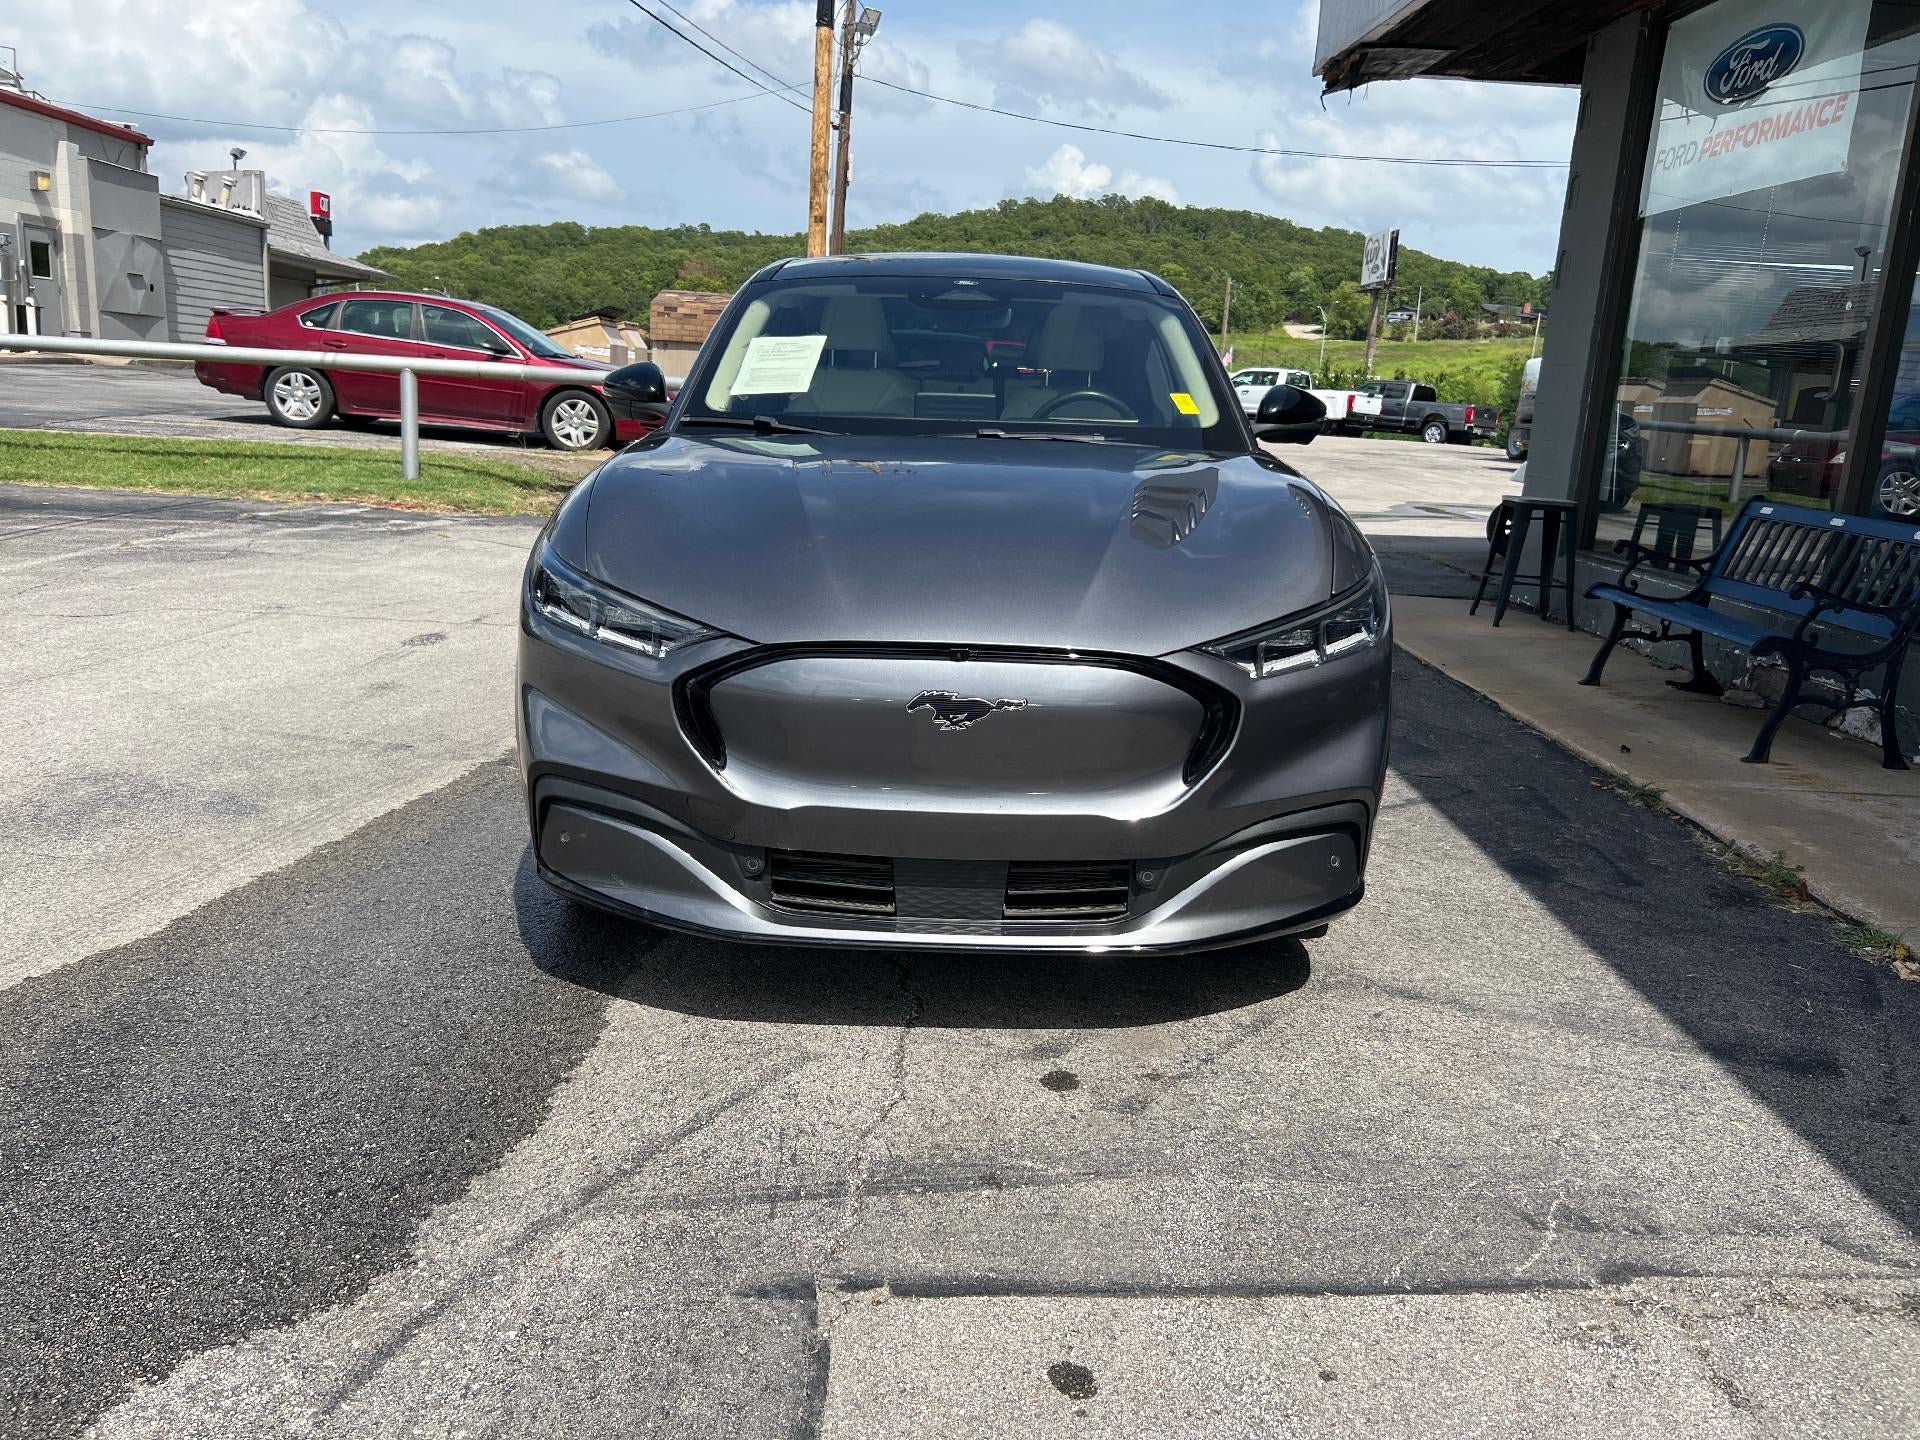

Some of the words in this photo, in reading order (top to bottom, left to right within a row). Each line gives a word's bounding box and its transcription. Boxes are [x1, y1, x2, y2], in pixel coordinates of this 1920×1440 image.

[1720, 38, 1784, 94] Ford
[1654, 140, 1698, 172] FORD
[1699, 93, 1849, 161] PERFORMANCE
